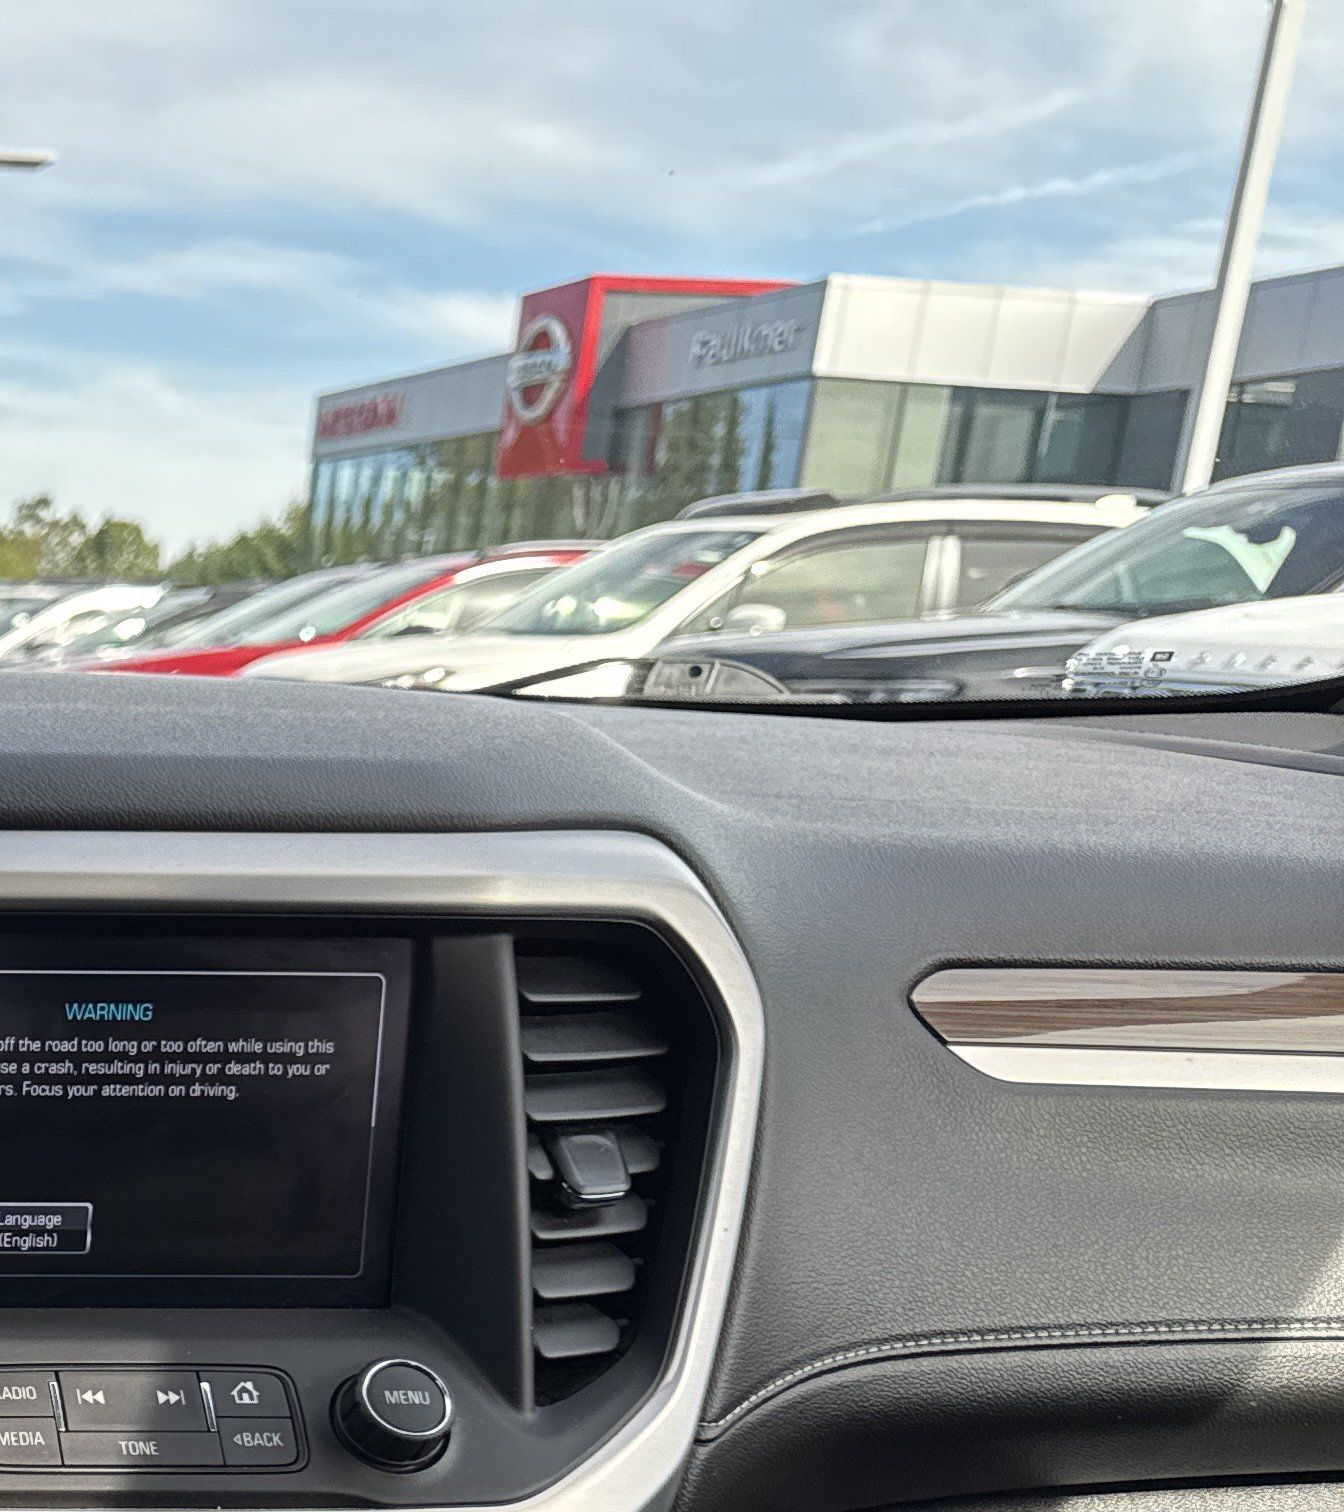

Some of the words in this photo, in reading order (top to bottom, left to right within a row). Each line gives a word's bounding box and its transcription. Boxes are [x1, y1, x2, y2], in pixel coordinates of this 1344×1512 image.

[65, 1002, 153, 1021] WARNING
[18, 1036, 42, 1052] the
[44, 1037, 78, 1052] road
[81, 1039, 105, 1053] too
[108, 1037, 138, 1056] long
[140, 1040, 157, 1053] or
[160, 1040, 184, 1053] too
[187, 1037, 224, 1053] often
[227, 1037, 264, 1053] while
[266, 1039, 305, 1057] using
[307, 1038, 335, 1054] this
[21, 1062, 30, 1074] a
[33, 1059, 78, 1076] crash,
[81, 1059, 145, 1078] resulting
[147, 1060, 161, 1075] in
[163, 1061, 203, 1078] injury
[205, 1063, 222, 1075] or
[224, 1060, 265, 1076] death
[268, 1062, 283, 1076] to
[286, 1063, 311, 1079] you
[313, 1063, 331, 1076] or
[22, 1080, 64, 1097] Focus
[66, 1084, 98, 1100] your
[101, 1083, 165, 1097] attention
[168, 1085, 186, 1097] on
[189, 1081, 240, 1101] driving.
[384, 1389, 431, 1406] MENU
[117, 1440, 160, 1456] TONE
[243, 1432, 284, 1447] BACK
